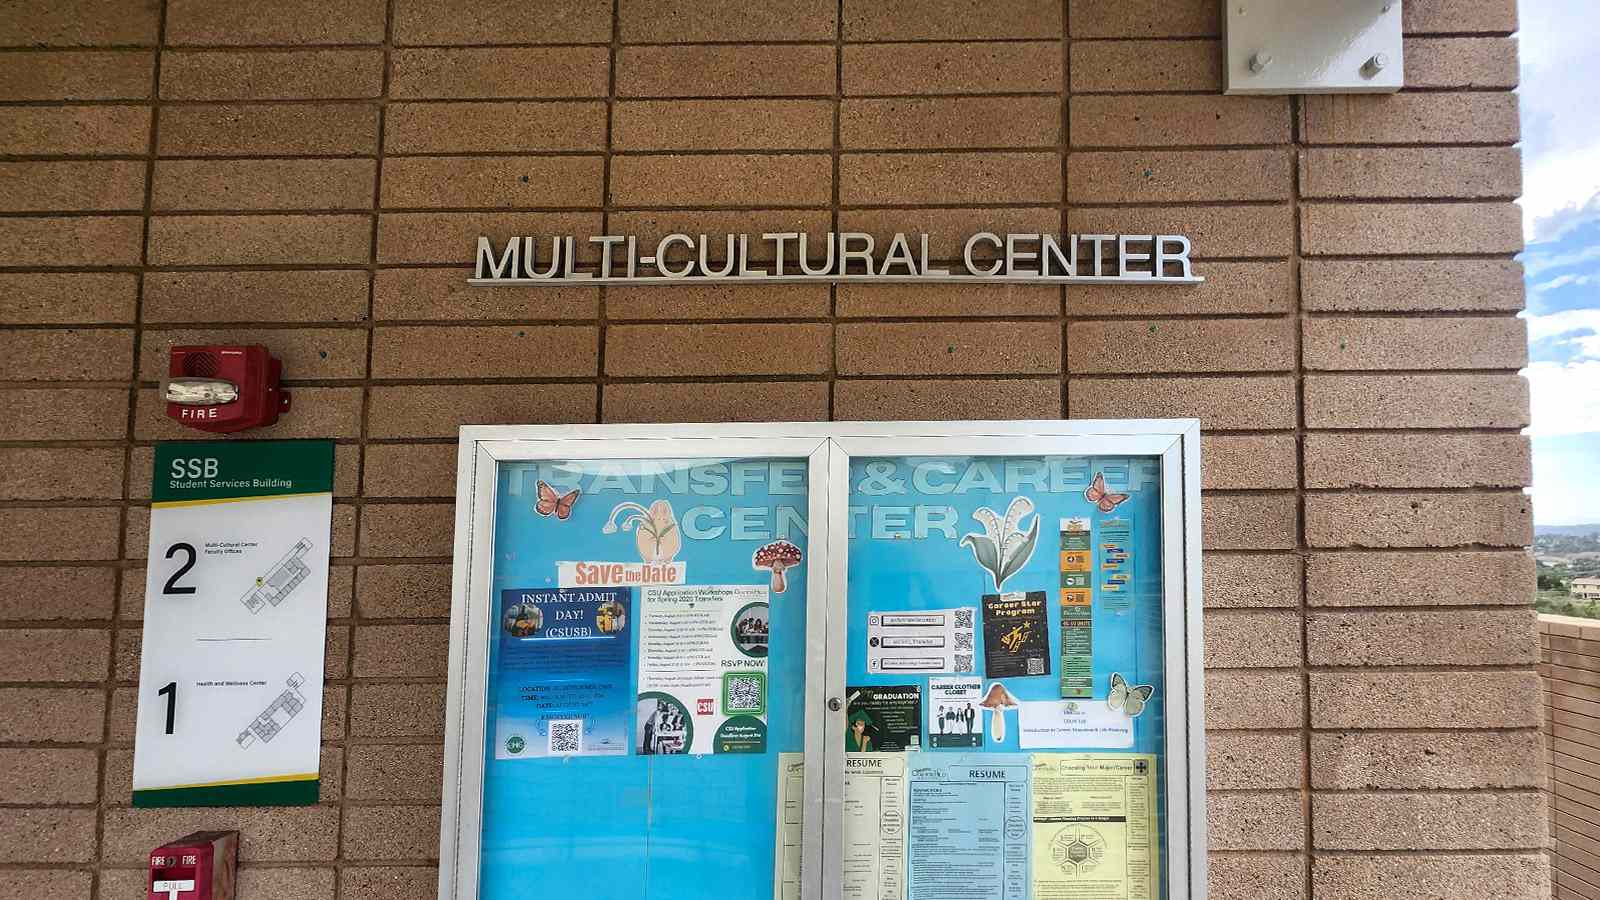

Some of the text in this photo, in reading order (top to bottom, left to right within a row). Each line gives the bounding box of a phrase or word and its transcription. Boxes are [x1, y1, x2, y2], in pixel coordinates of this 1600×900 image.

[475, 232, 1196, 280] MULTI-CULTURAL CENTER
[182, 408, 217, 419] FIRE
[171, 458, 219, 479] SSB
[169, 478, 293, 489] Student Services Building
[503, 461, 853, 496] TRANSFE
[163, 543, 197, 594] 2
[575, 562, 676, 585] Save the Date
[521, 592, 617, 604] INSTANT ADMIT
[556, 609, 584, 620] DAY!
[996, 608, 1035, 617] Program
[545, 626, 592, 638] (CSUSB)
[158, 681, 177, 735] 1
[697, 702, 714, 713] CSU
[847, 759, 882, 768] RESUME
[969, 769, 1006, 779] RESUME
[152, 856, 166, 866] FIRE
[182, 855, 197, 865] FIRE
